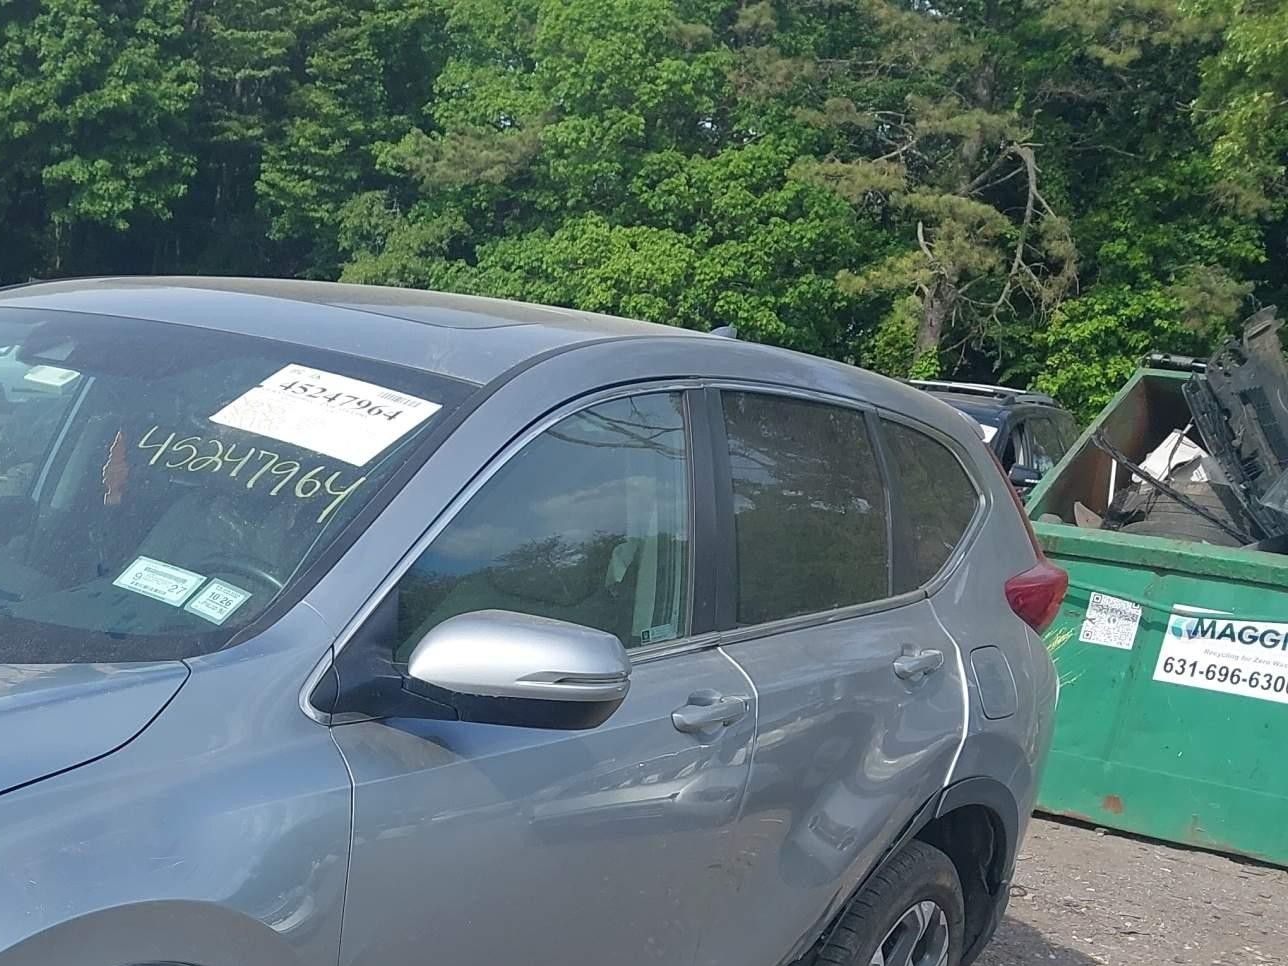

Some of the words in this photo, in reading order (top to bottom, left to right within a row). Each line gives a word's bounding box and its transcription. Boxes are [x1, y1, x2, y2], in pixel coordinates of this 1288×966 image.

[279, 380, 403, 421] 45247964
[138, 426, 366, 523] 45247964
[1163, 656, 1288, 695] 631-696-630
